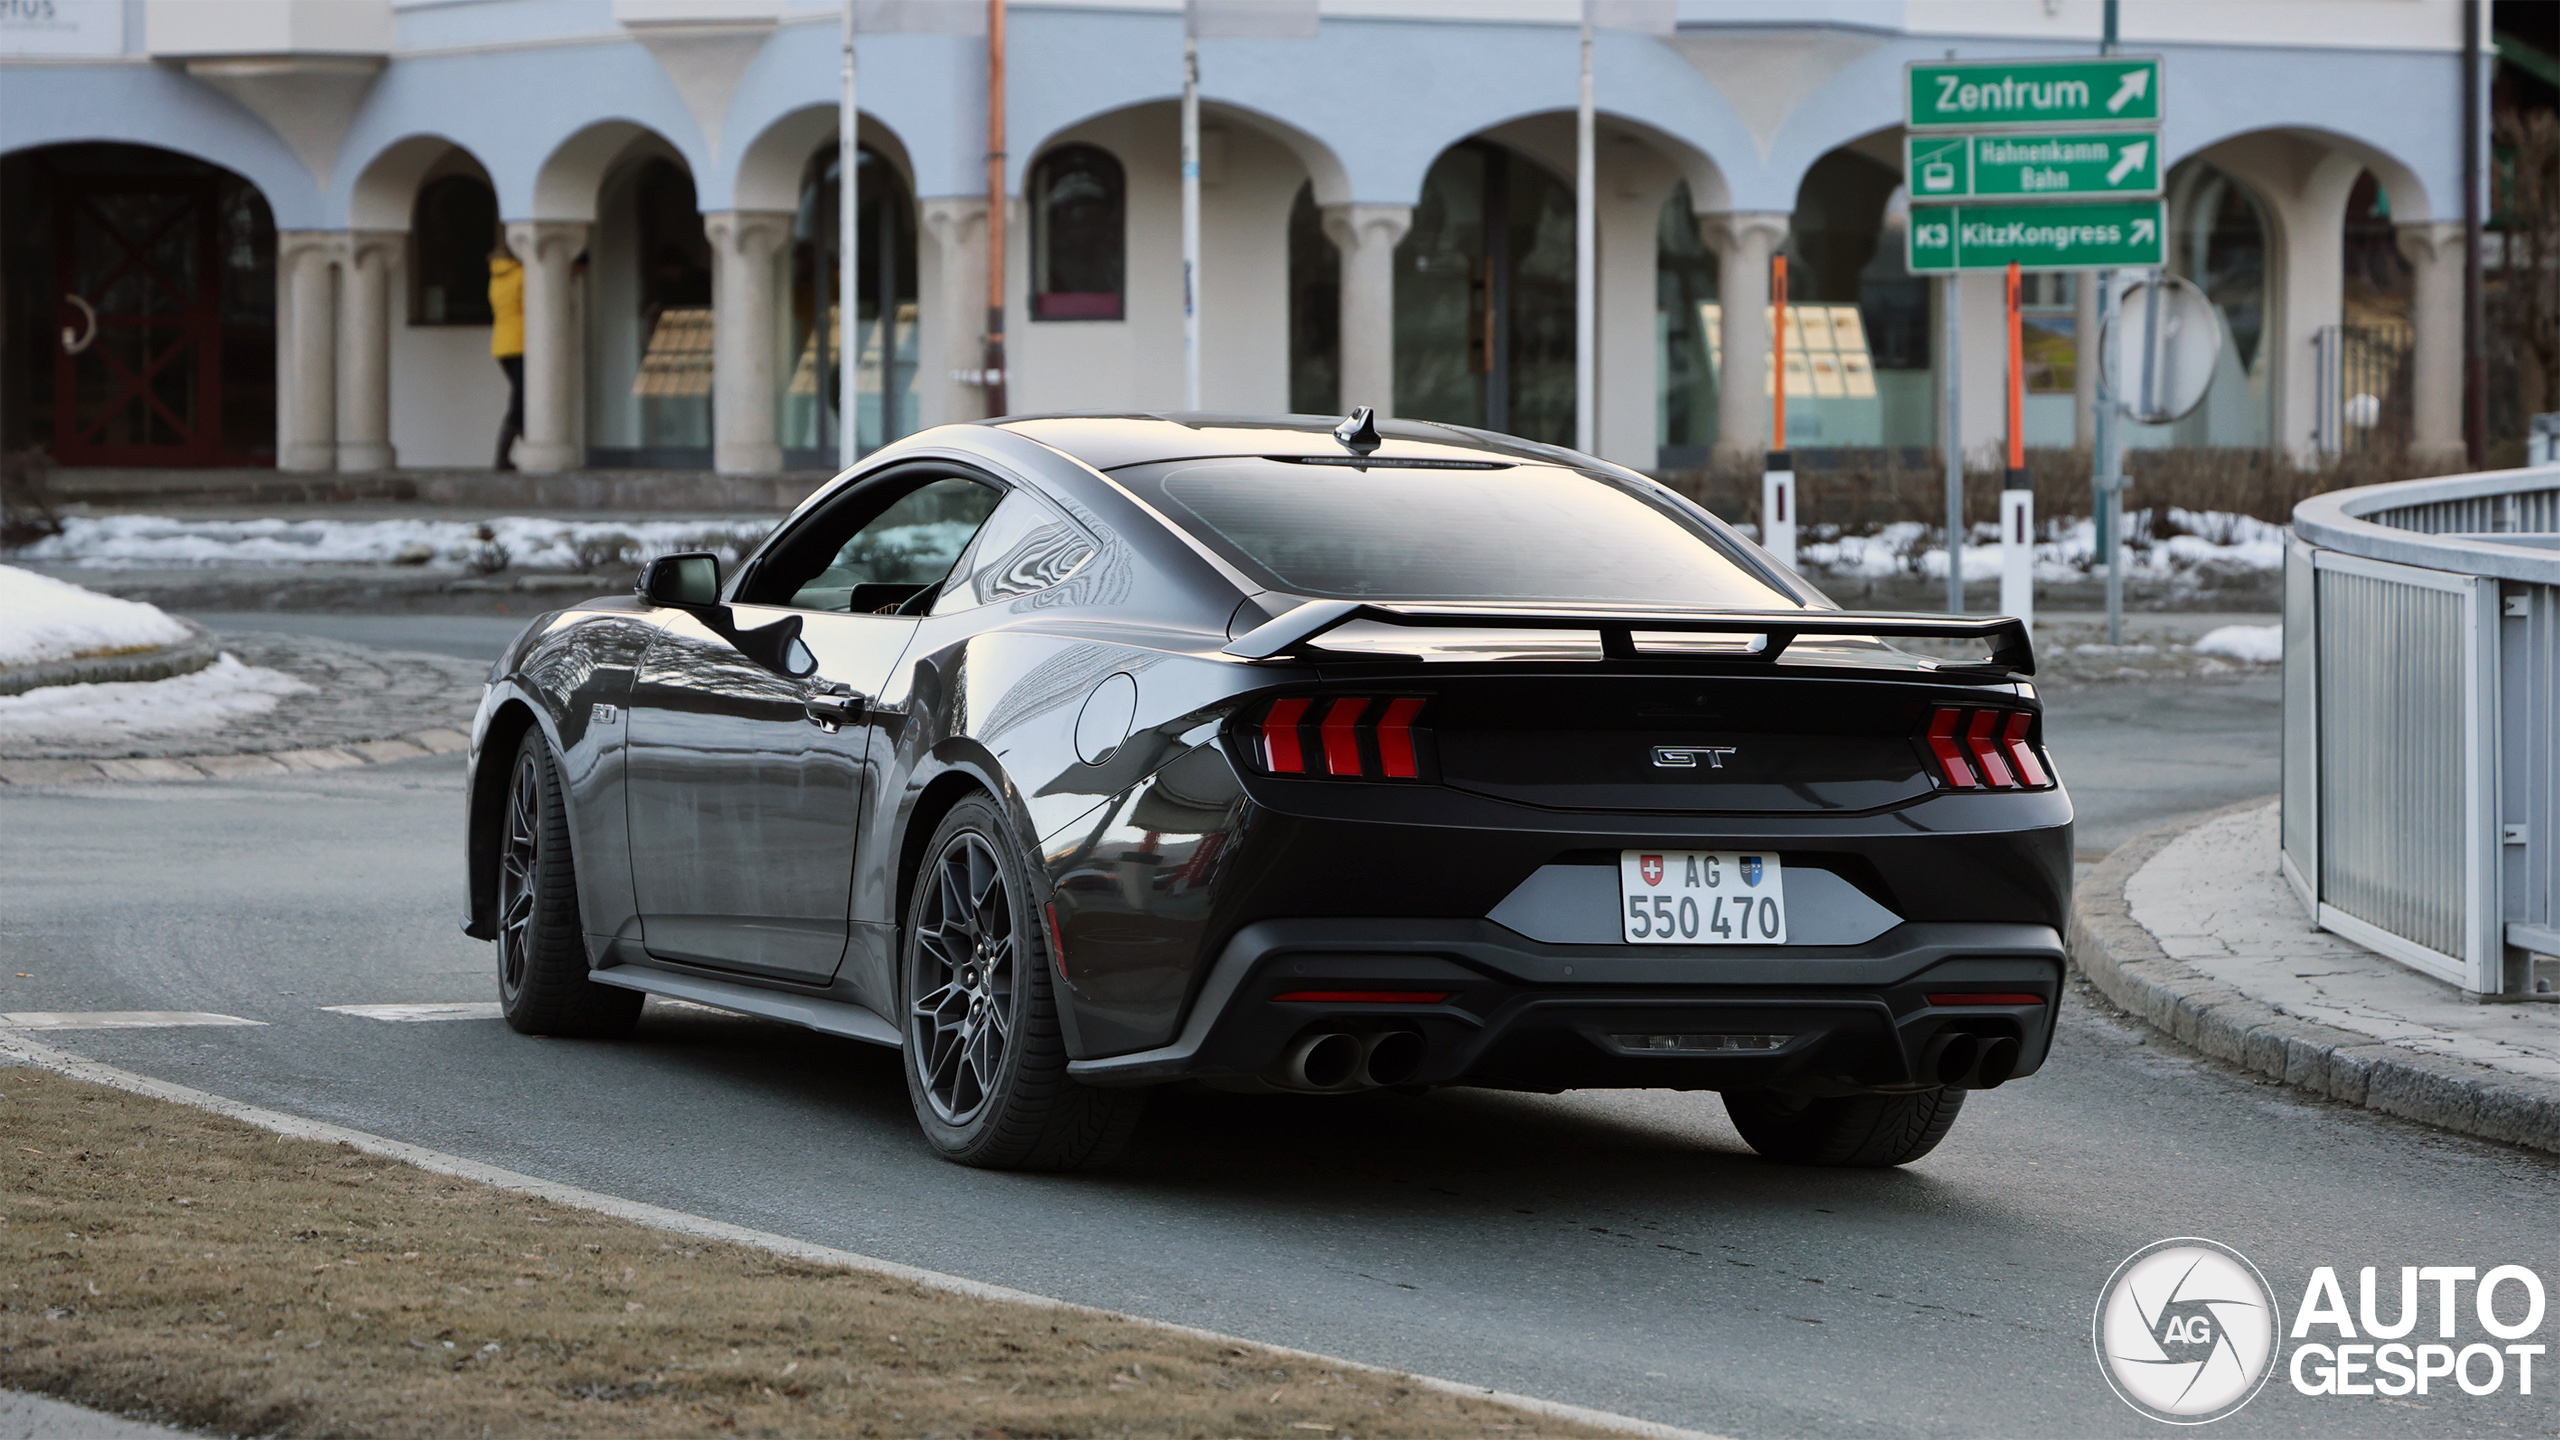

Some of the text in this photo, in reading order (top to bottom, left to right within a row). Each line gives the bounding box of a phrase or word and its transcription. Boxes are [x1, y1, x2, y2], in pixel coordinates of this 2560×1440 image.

[1935, 75, 2089, 112] Zentrum
[1980, 139, 2109, 164] Hahnenkamm
[2020, 166, 2070, 191] Bahn
[1916, 221, 2121, 250] K3 KitzKongress
[1650, 745, 1737, 768] GT
[1685, 855, 1721, 888] AG
[1629, 895, 1780, 939] 550 470
